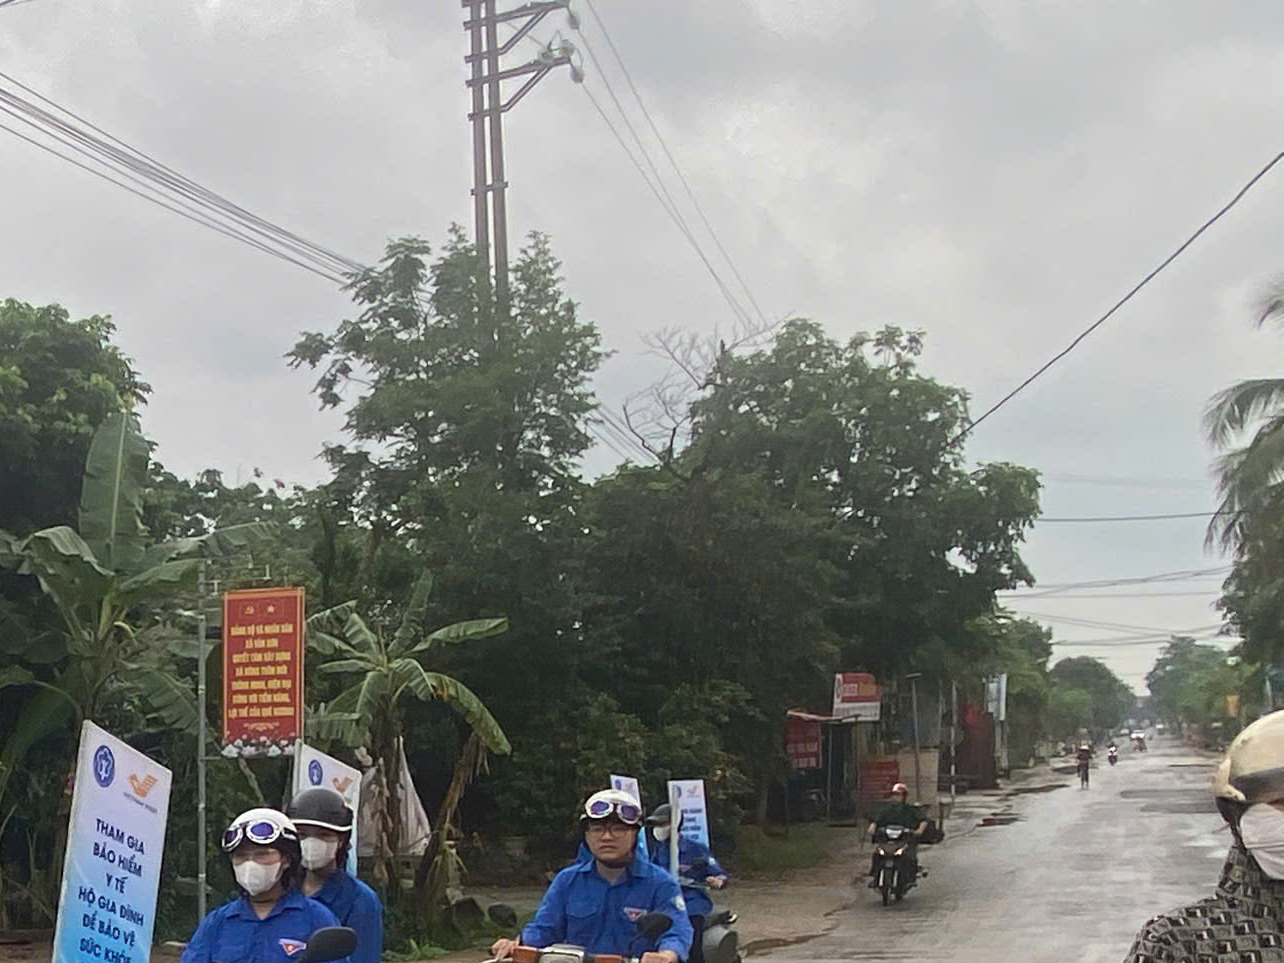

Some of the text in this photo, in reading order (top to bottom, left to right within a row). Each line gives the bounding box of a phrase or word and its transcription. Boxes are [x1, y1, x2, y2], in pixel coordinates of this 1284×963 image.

[96, 818, 145, 855] THAM GIA
[92, 842, 143, 877] BẢO HIỂM
[106, 873, 128, 894] Y TẾ
[78, 886, 96, 908] HỘ
[98, 895, 117, 915] GIA
[98, 919, 121, 941] BẢO
